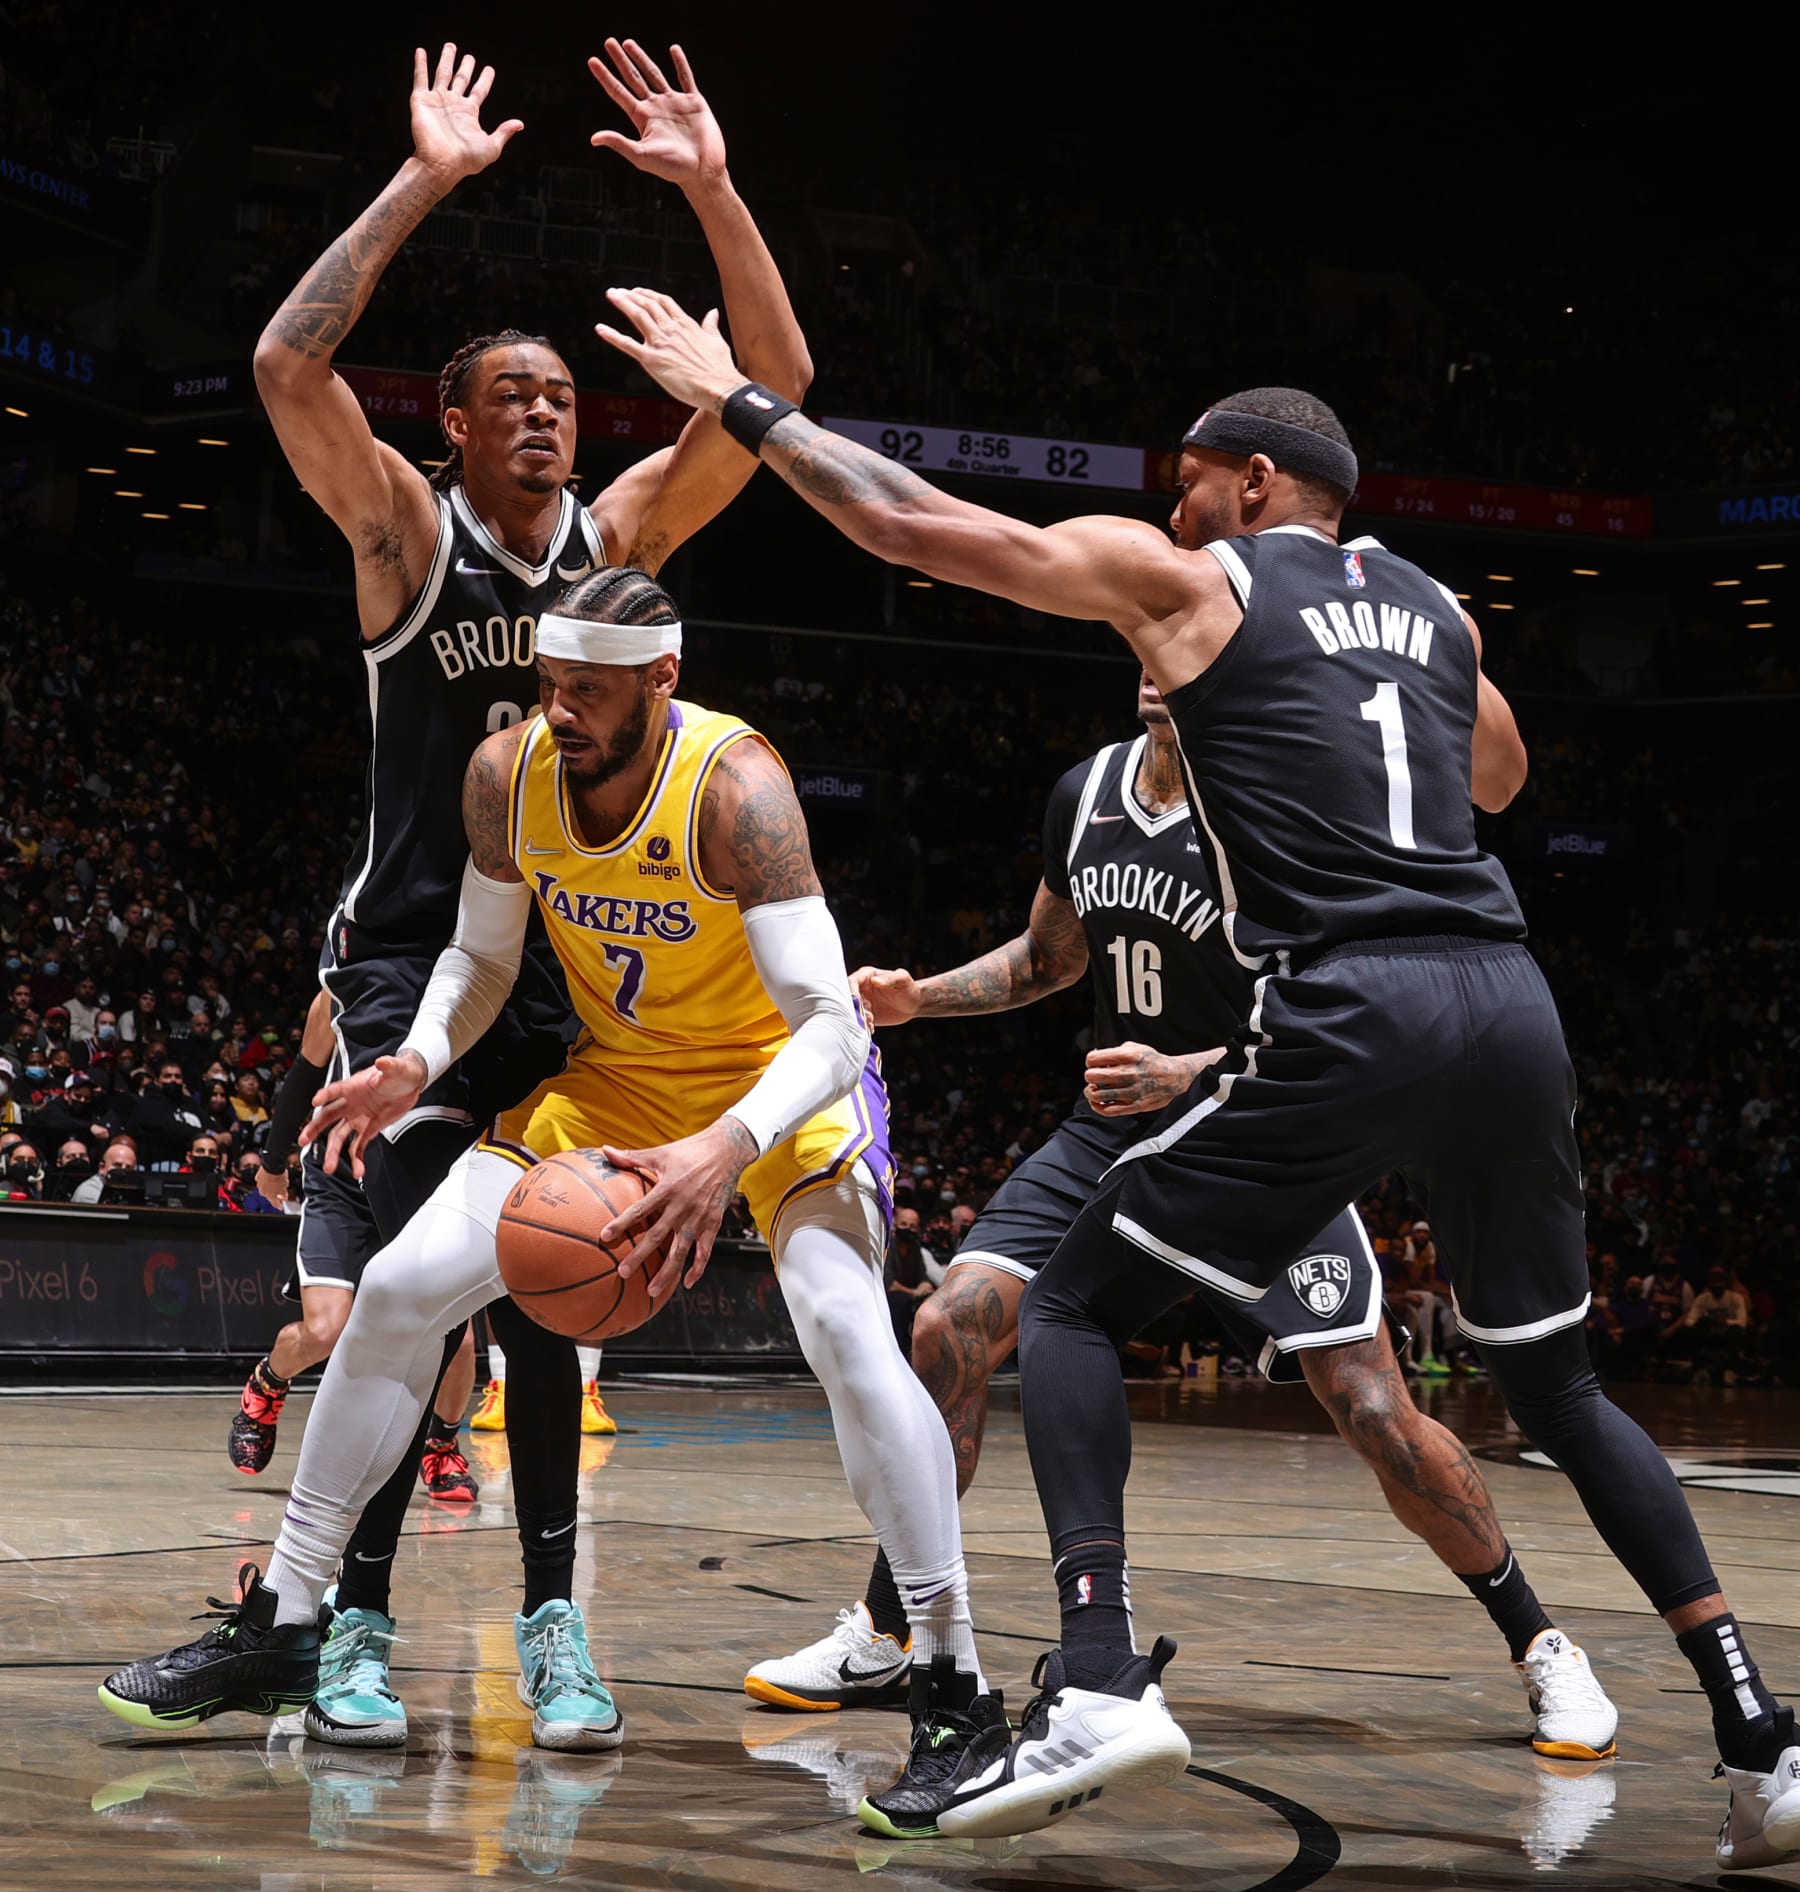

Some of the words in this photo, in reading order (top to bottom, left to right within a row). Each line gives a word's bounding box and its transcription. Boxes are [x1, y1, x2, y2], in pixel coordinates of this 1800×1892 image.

[29, 169, 90, 209] CENTER
[0, 326, 30, 363] 14
[38, 339, 56, 373] &
[63, 348, 94, 384] 15
[173, 380, 202, 397] 9:23
[205, 376, 228, 393] PM
[612, 419, 632, 435] 22
[880, 429, 924, 462] 92
[958, 434, 1011, 459] 8:56
[947, 457, 968, 471] 4th
[971, 459, 1021, 476] Quarter
[1046, 446, 1089, 479] 82
[429, 614, 537, 681] BROO
[1299, 600, 1435, 667] BROWN
[1359, 682, 1418, 849] 1
[799, 773, 864, 799] jetBlue
[1186, 841, 1201, 854] We
[1545, 831, 1608, 857] jetBlue
[638, 861, 681, 881] bibigo
[534, 871, 698, 943] LAKERS
[1069, 862, 1222, 943] BROOKLYN
[599, 941, 645, 1024] 7
[1107, 935, 1164, 1018] 16
[0, 1259, 70, 1301] Pixel
[78, 1262, 98, 1301] 6
[197, 1266, 265, 1306] Pixel
[1293, 1258, 1348, 1290] NETS
[1318, 1286, 1331, 1308] B
